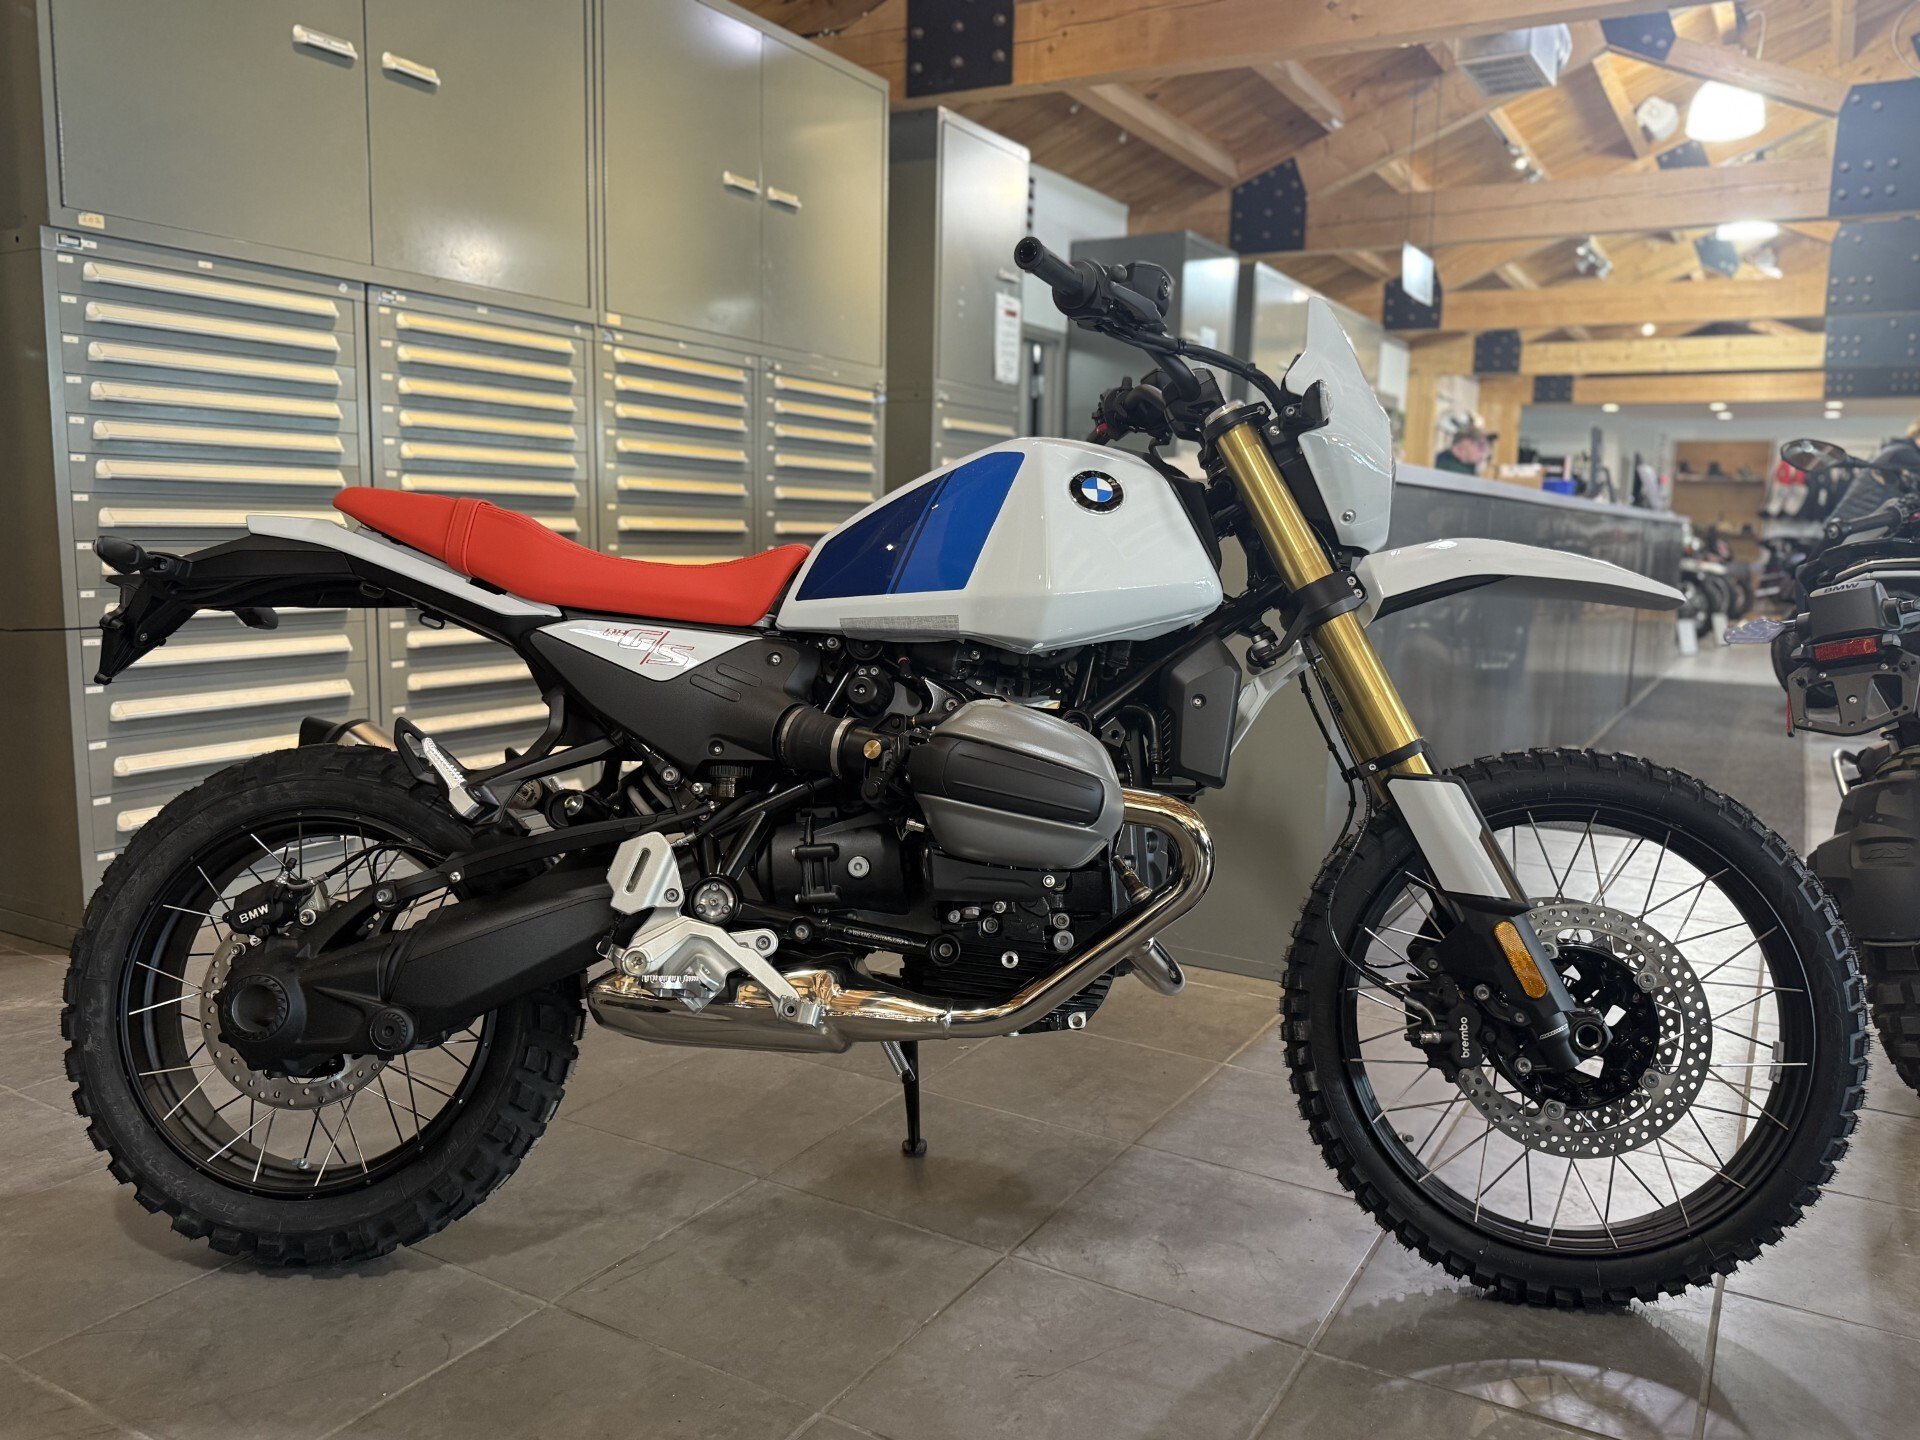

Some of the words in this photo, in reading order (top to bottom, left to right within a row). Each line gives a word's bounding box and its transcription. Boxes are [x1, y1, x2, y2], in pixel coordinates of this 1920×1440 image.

[1823, 582, 1860, 594] BMW
[239, 903, 269, 924] BMW
[1458, 1016, 1470, 1059] brembo
